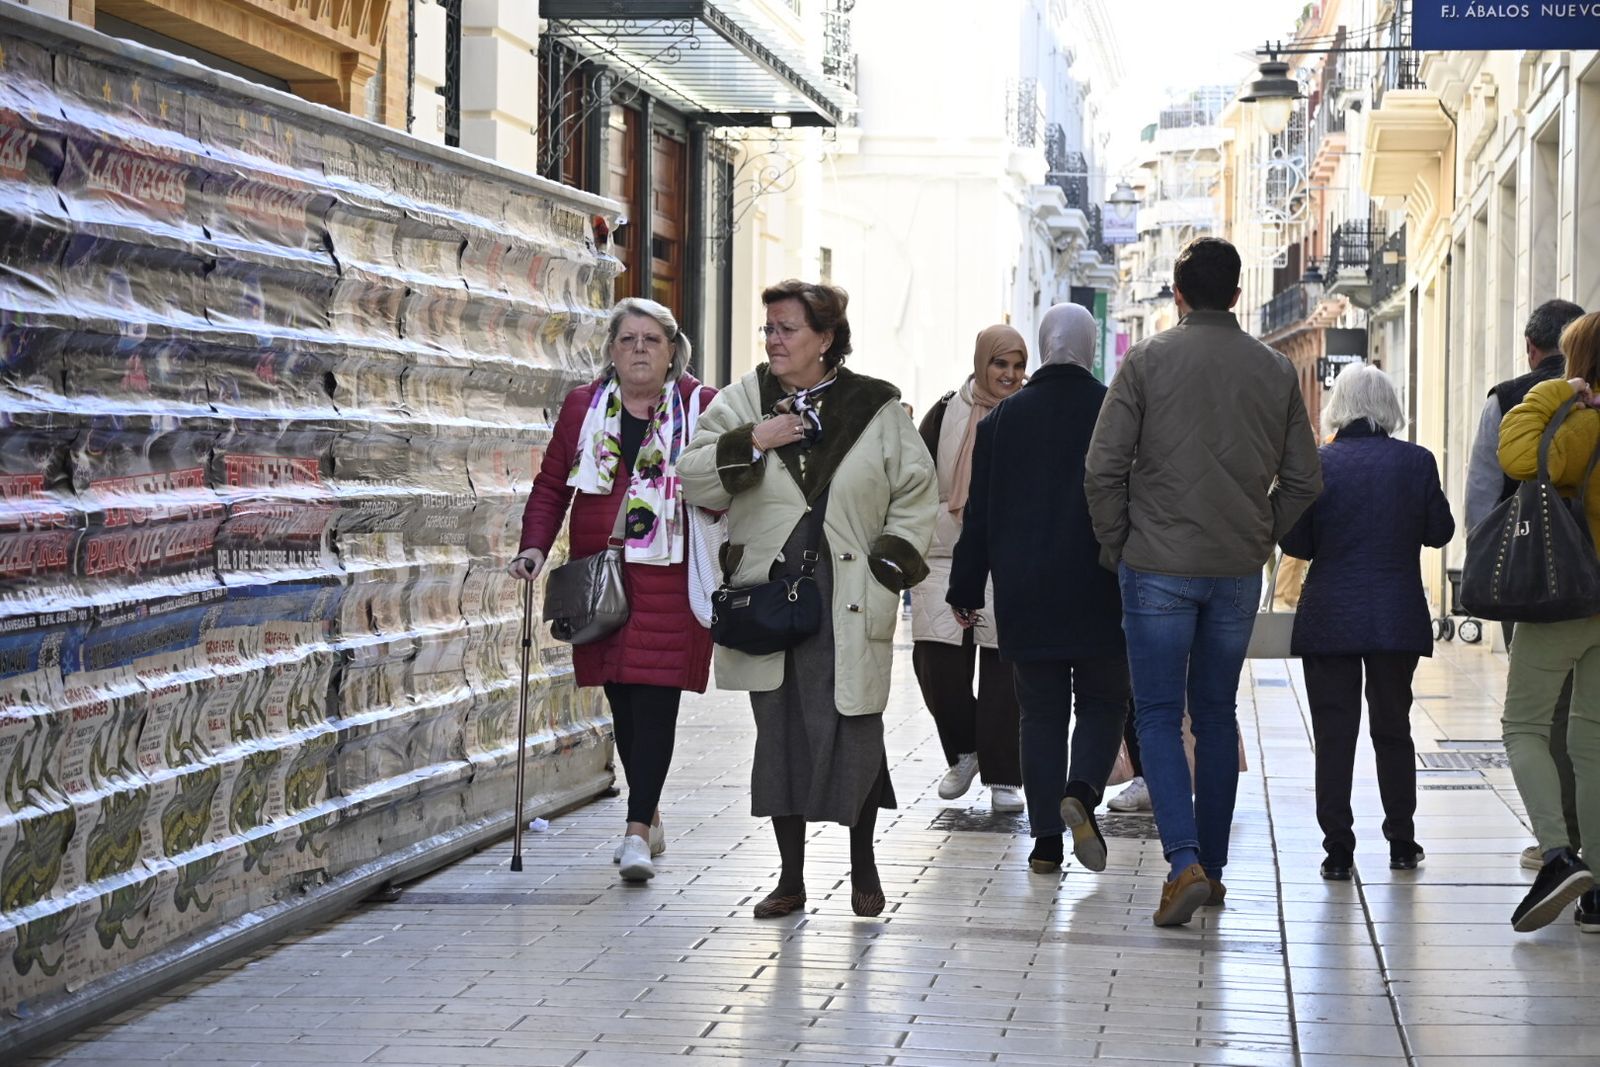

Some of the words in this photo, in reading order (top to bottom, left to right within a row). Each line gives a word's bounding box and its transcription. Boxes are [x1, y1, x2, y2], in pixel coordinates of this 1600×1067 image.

[1465, 1, 1530, 18] ÁBALOS
[87, 147, 128, 197] LAS
[129, 156, 191, 205] VEGAS
[86, 526, 165, 576] PARQUE
[239, 549, 250, 570] DE
